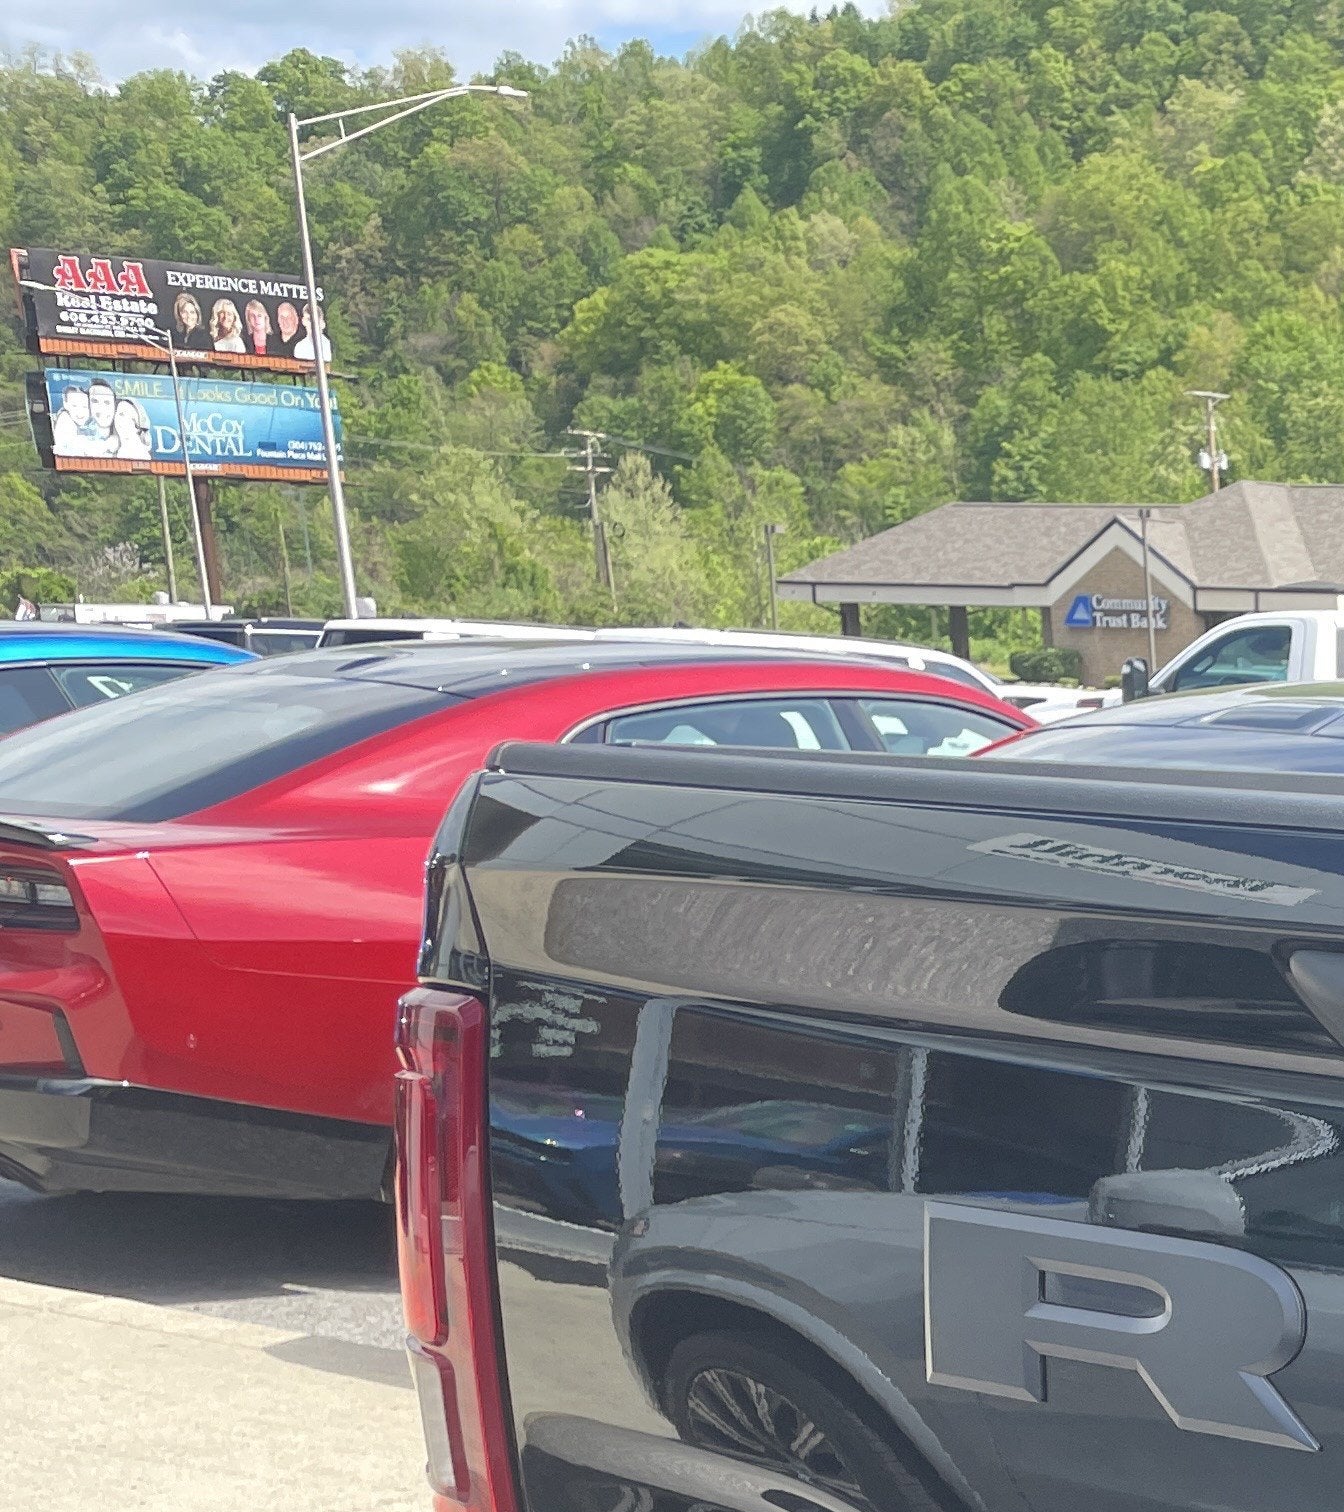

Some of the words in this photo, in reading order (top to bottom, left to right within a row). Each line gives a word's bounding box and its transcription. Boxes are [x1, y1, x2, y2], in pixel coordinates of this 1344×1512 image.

[53, 255, 153, 298] AAA
[166, 271, 258, 294] EXPERIENCE
[260, 280, 324, 302] MATTES
[99, 296, 158, 315] Estate
[235, 387, 278, 406] Good
[281, 390, 304, 407] On
[153, 425, 252, 457] DENTAL
[1092, 594, 1168, 614] Communty
[1093, 611, 1128, 628] Trust
